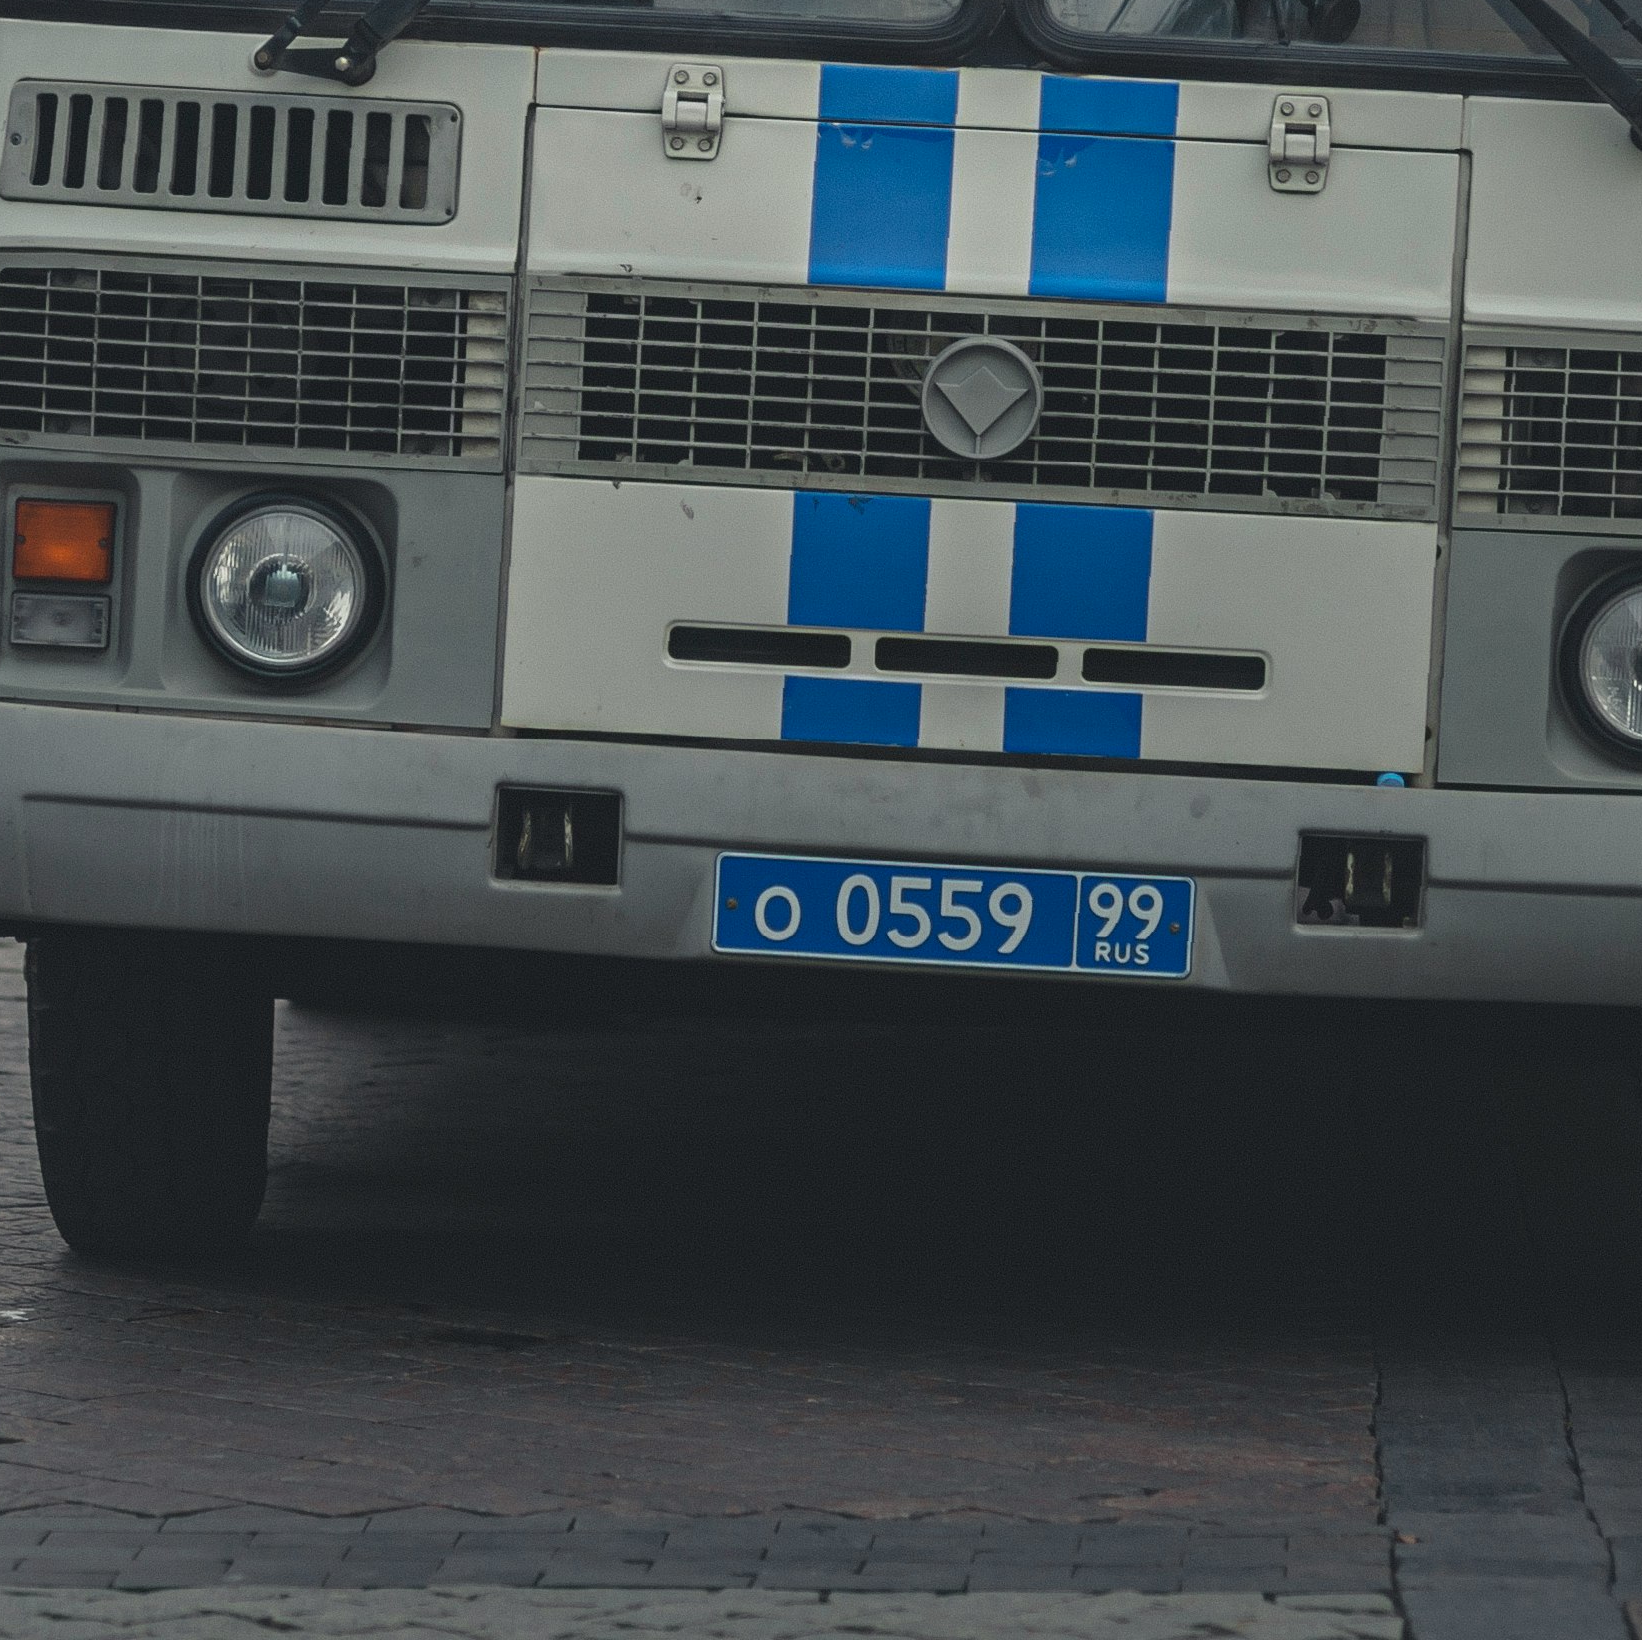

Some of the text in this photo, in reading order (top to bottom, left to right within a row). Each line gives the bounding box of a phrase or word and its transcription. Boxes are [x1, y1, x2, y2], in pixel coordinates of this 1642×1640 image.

[835, 873, 1035, 955] 0559
[1087, 882, 1165, 941] 99
[1093, 941, 1151, 965] RUS
